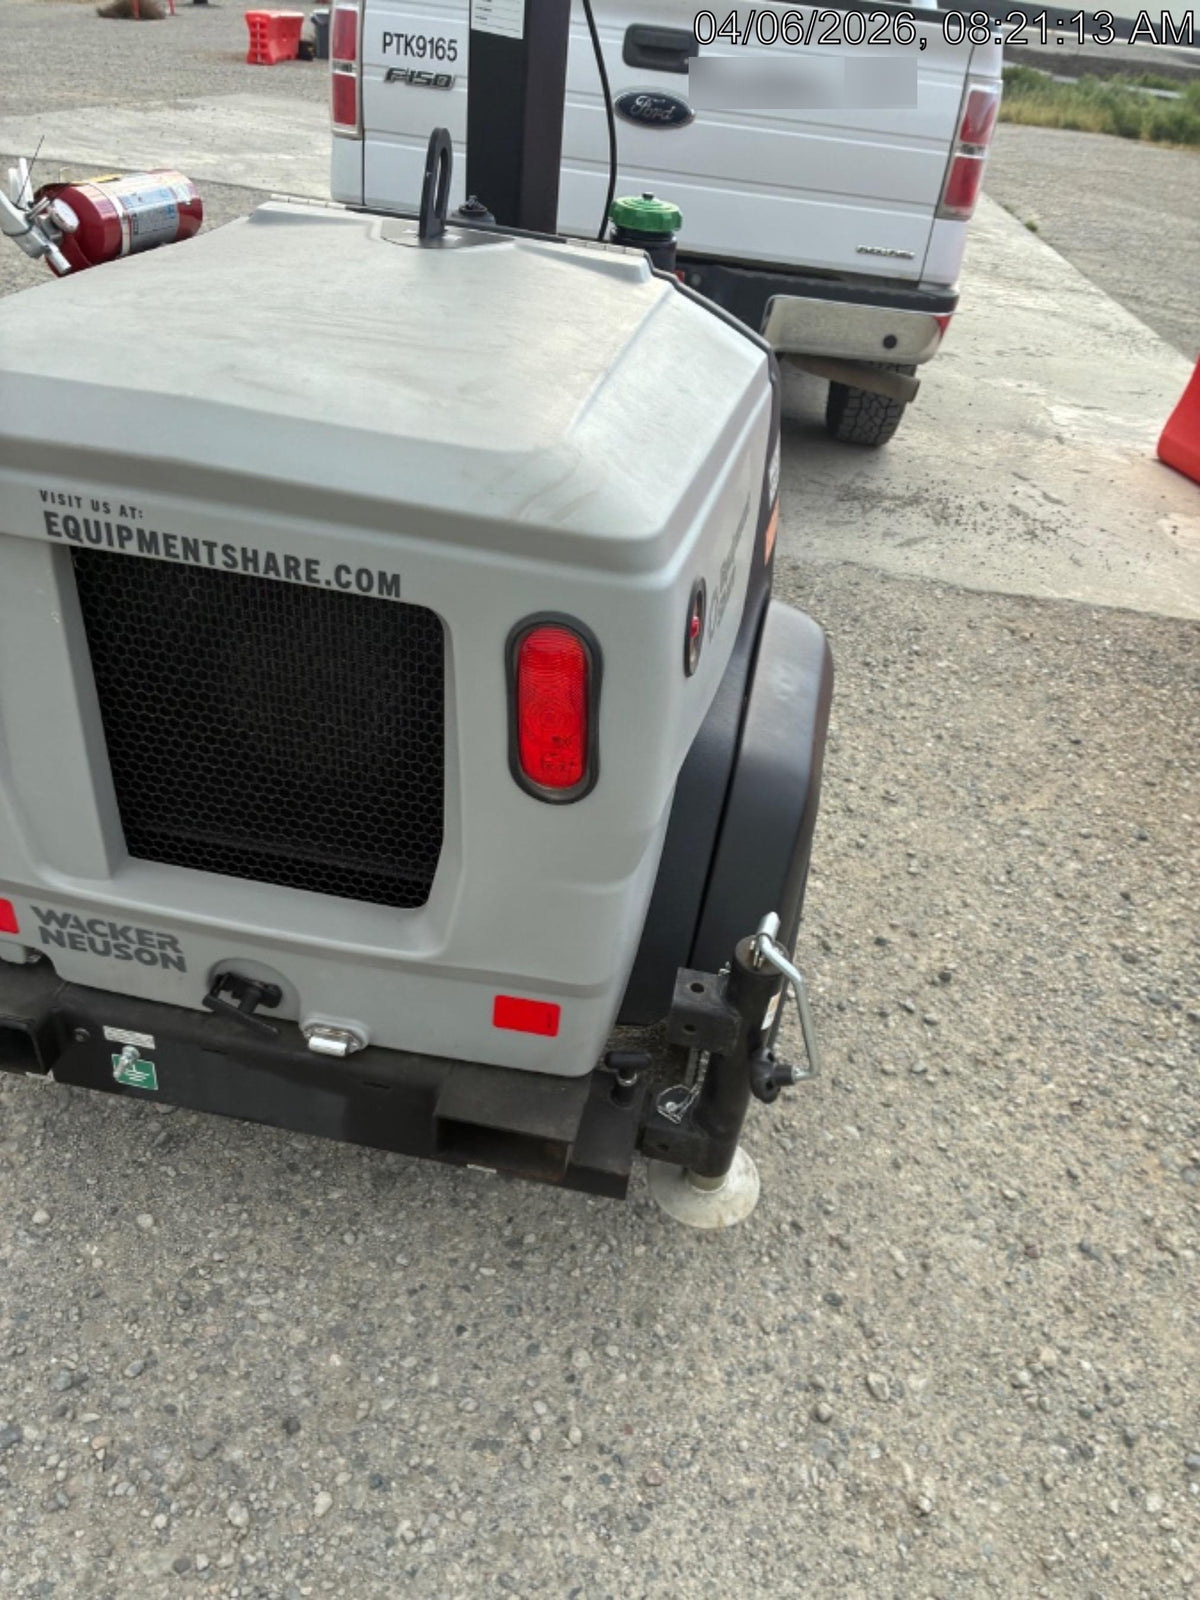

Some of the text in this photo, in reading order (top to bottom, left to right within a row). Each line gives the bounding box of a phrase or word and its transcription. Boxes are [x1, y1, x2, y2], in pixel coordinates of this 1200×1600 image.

[383, 31, 458, 62] PTK9165
[630, 95, 676, 119] Ford
[40, 489, 143, 520] VISIT US AT:
[44, 510, 401, 599] EQUIPMENTSHARE.COM
[30, 905, 183, 953] WACKER
[38, 926, 187, 973] NEUSON
